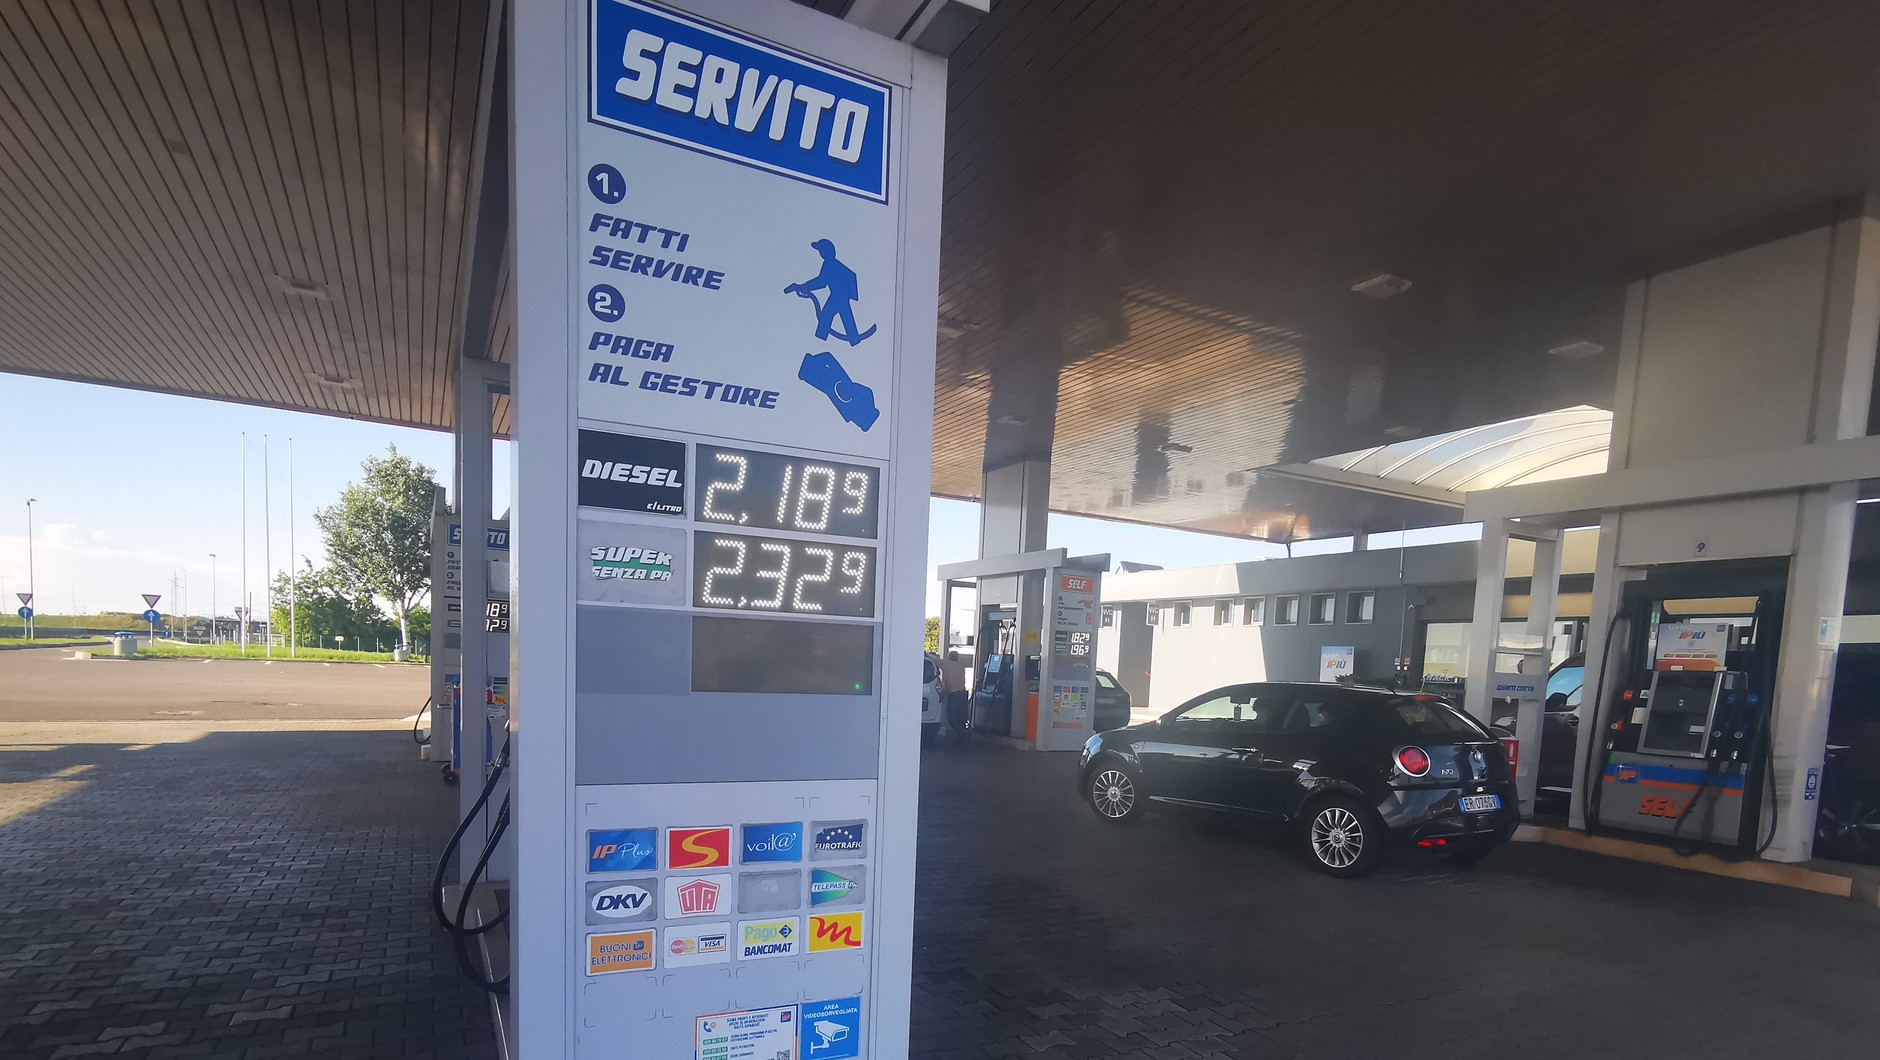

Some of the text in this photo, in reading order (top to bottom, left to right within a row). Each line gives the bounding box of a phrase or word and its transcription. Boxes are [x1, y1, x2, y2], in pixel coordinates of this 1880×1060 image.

[615, 28, 869, 164] SERVITO
[595, 172, 619, 197] 1.
[588, 213, 690, 253] FATTI
[588, 245, 725, 290] SERVIRE
[594, 291, 619, 316] 2.
[588, 331, 675, 363] PAGA
[588, 362, 780, 410] AL GESTORE
[581, 458, 683, 489] DIESEL
[591, 566, 648, 580] SENZA
[1067, 579, 1087, 590] SELF
[592, 842, 654, 860] IP Plus
[813, 882, 847, 891] TELEPASS
[595, 892, 649, 911] DKV
[678, 880, 720, 914] UTA
[745, 925, 778, 941] Pago
[599, 943, 631, 954] BUONI
[704, 940, 721, 948] VISA
[743, 942, 793, 957] BANCOMAT
[591, 952, 652, 966] ELETTRONICI
[803, 1007, 858, 1020] VIDEOSORVEGLIATA
[823, 1003, 840, 1011] AREA
